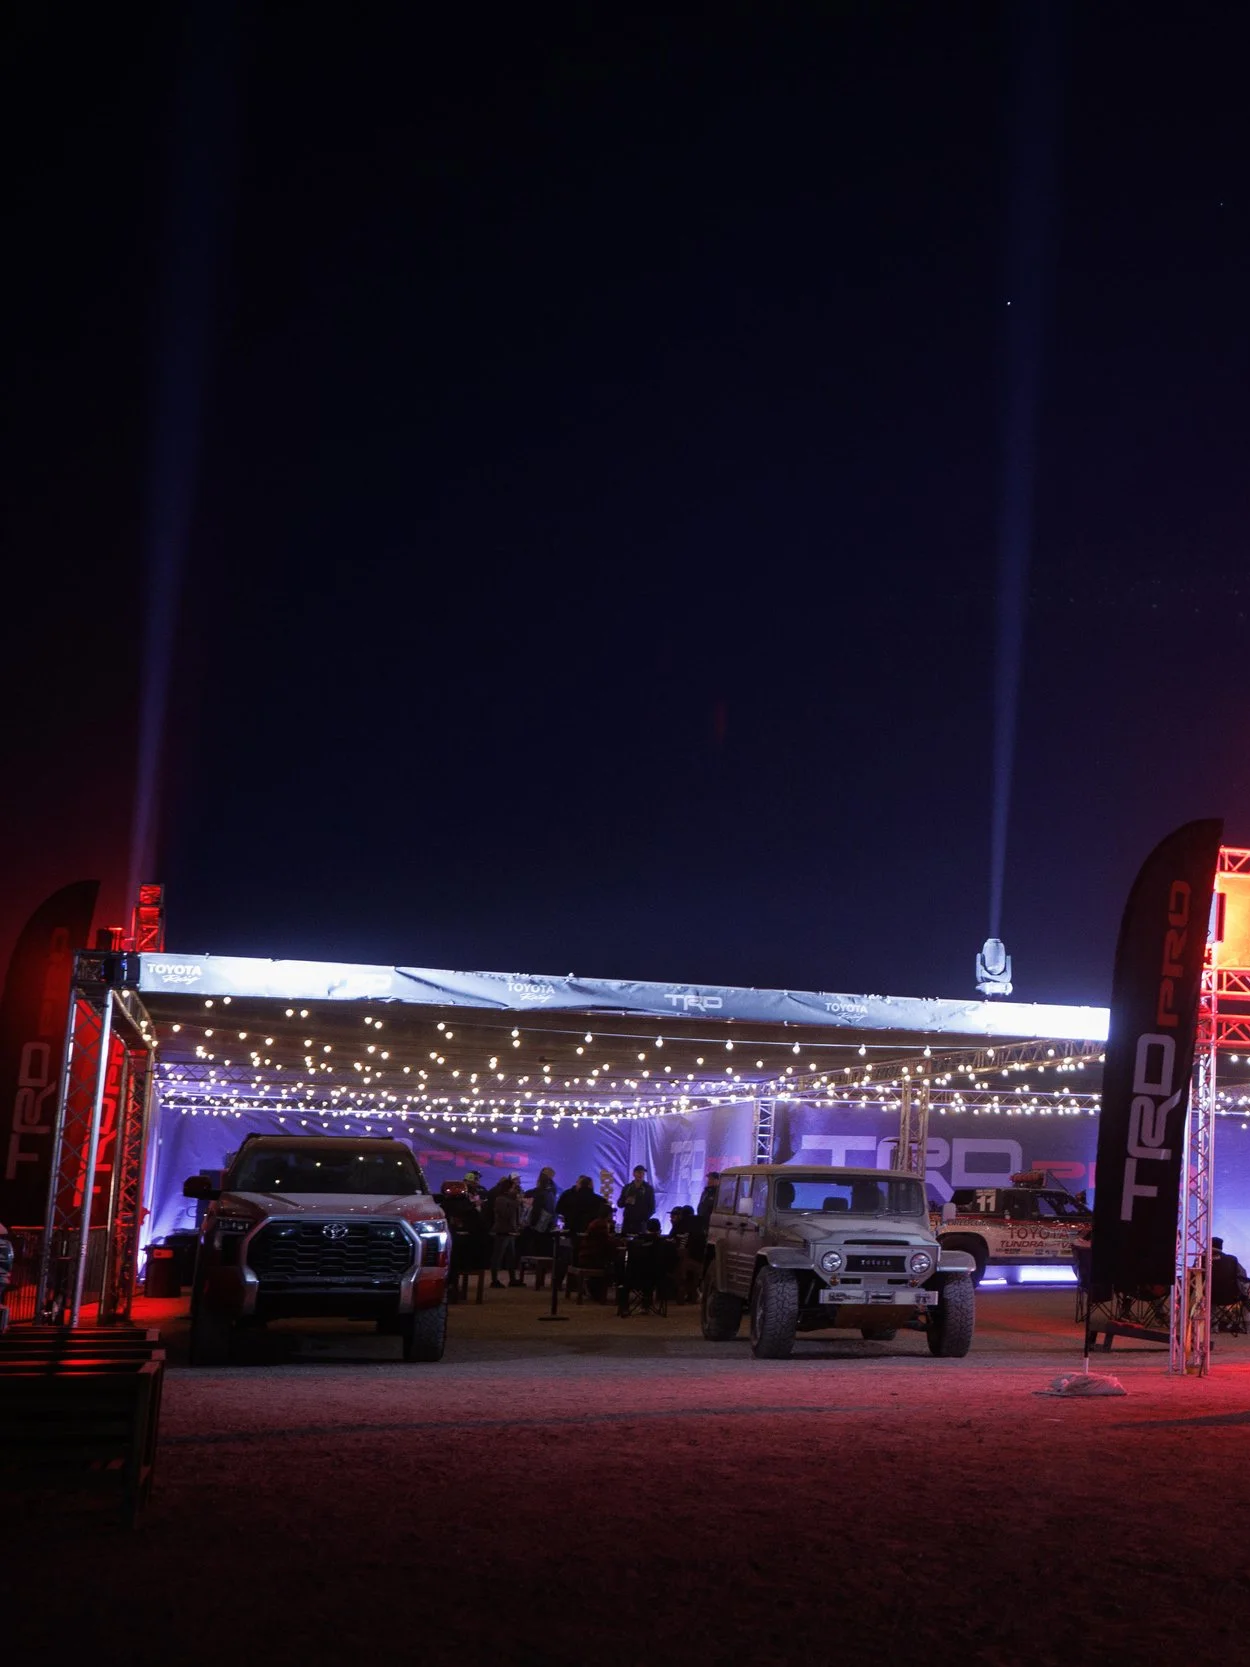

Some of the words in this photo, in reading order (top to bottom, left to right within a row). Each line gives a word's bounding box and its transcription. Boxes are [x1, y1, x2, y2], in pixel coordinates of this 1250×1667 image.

[147, 963, 203, 977] TOYOTA
[506, 982, 556, 995] TOYOTA
[664, 993, 723, 1012] TRD
[824, 1001, 869, 1014] TOYOTA
[1120, 1032, 1182, 1222] TRD
[1157, 880, 1192, 1028] PRO
[5, 1041, 57, 1181] TRD
[416, 1150, 529, 1169] PRO
[976, 1195, 996, 1212] 11
[1008, 1227, 1070, 1240] TOYOTA
[1000, 1240, 1045, 1249] TUNDRA
